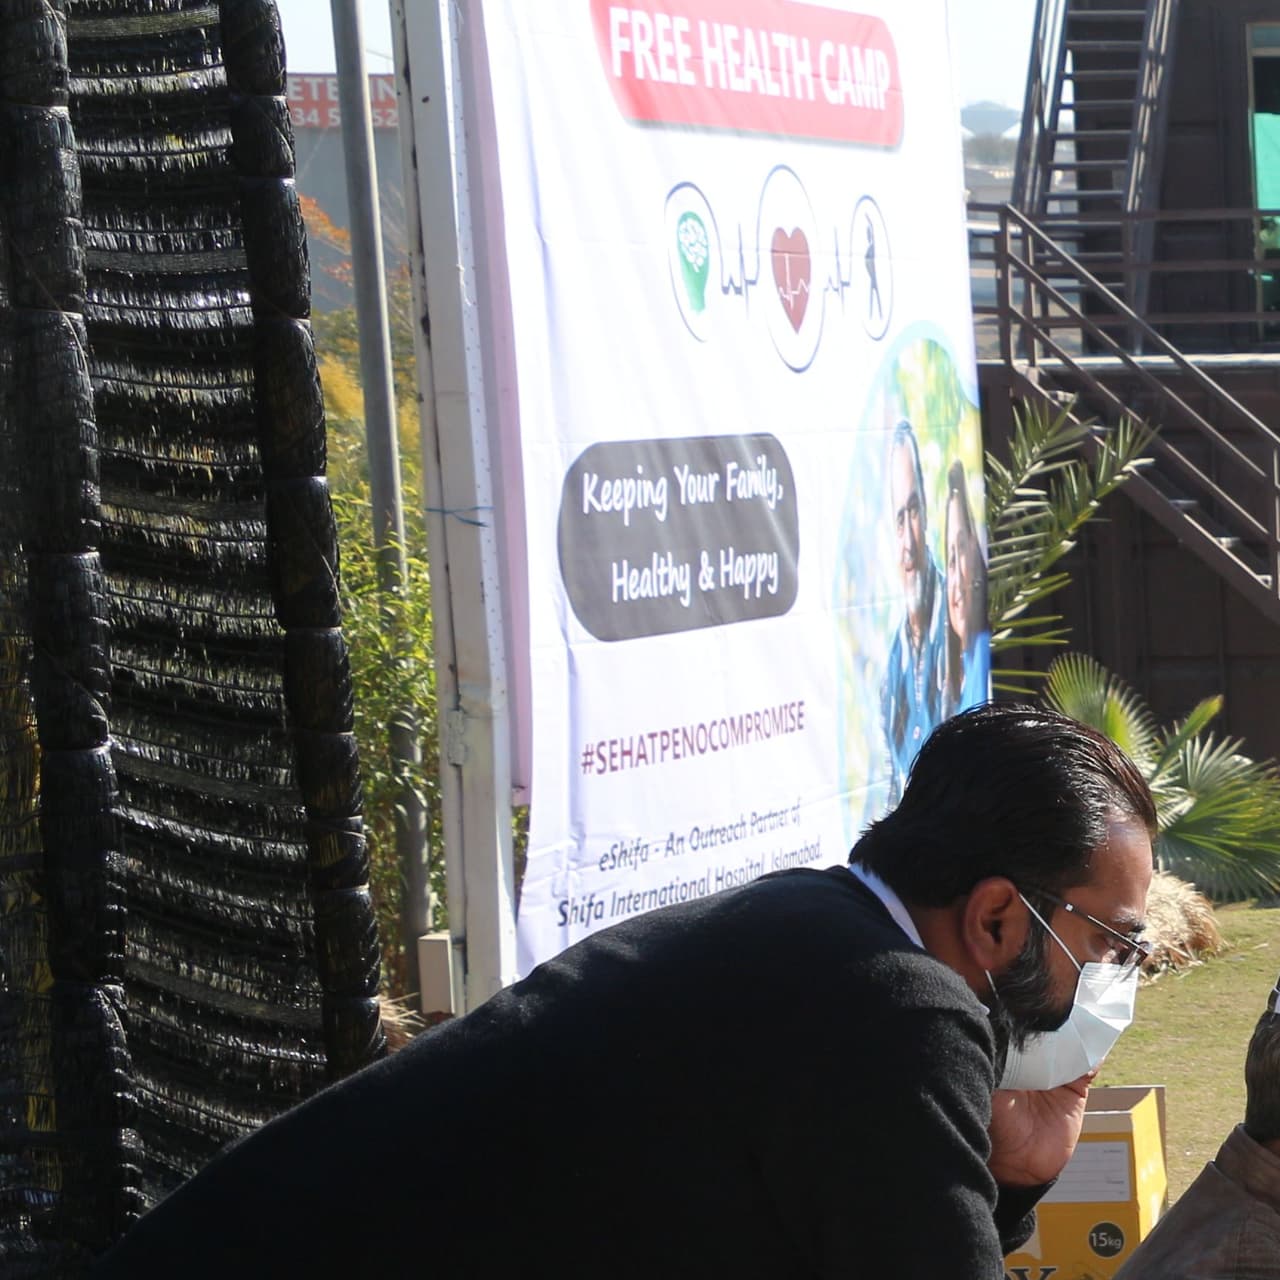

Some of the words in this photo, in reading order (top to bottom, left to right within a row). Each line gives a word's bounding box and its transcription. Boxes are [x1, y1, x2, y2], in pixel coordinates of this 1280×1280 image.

[609, 6, 697, 86] FREE
[699, 20, 815, 101] HEALTH
[818, 39, 891, 110] CAMP
[583, 464, 668, 526] Keeping
[673, 464, 720, 505] Your
[726, 454, 784, 510] Family,
[612, 551, 690, 607] Healthy
[699, 550, 715, 591] &
[720, 547, 778, 600] Happy
[581, 700, 805, 775] #SEHATPENOCOMPROMISE
[599, 837, 649, 872] eShifa
[665, 832, 685, 858] An
[689, 814, 747, 852] Outreach
[750, 808, 788, 835] Partner
[557, 893, 605, 928] Shifa
[609, 868, 711, 917] International
[1091, 1232, 1122, 1249] 15kg
